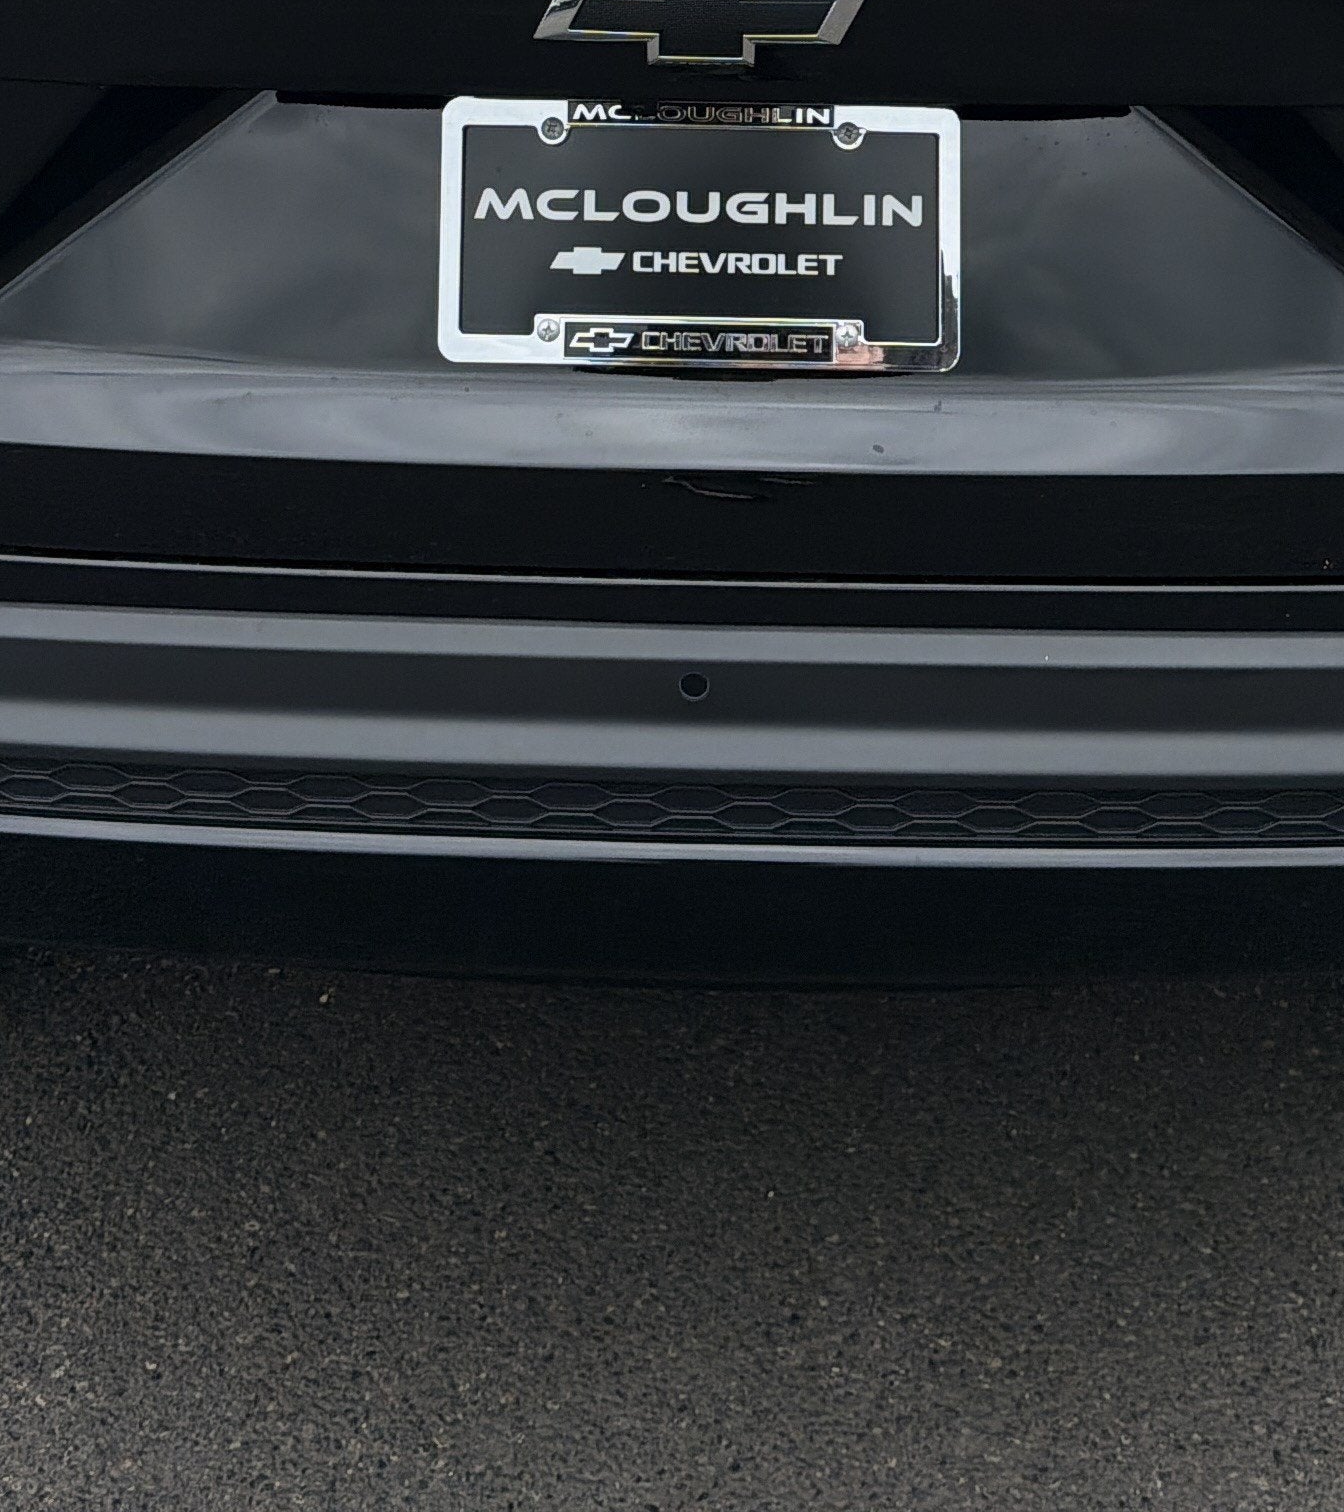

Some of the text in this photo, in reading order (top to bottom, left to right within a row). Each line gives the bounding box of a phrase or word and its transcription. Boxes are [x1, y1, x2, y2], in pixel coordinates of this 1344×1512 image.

[474, 187, 923, 227] MCLOUGHLIN
[632, 251, 843, 276] CHEVROLET
[642, 331, 829, 355] CHEVROLET
